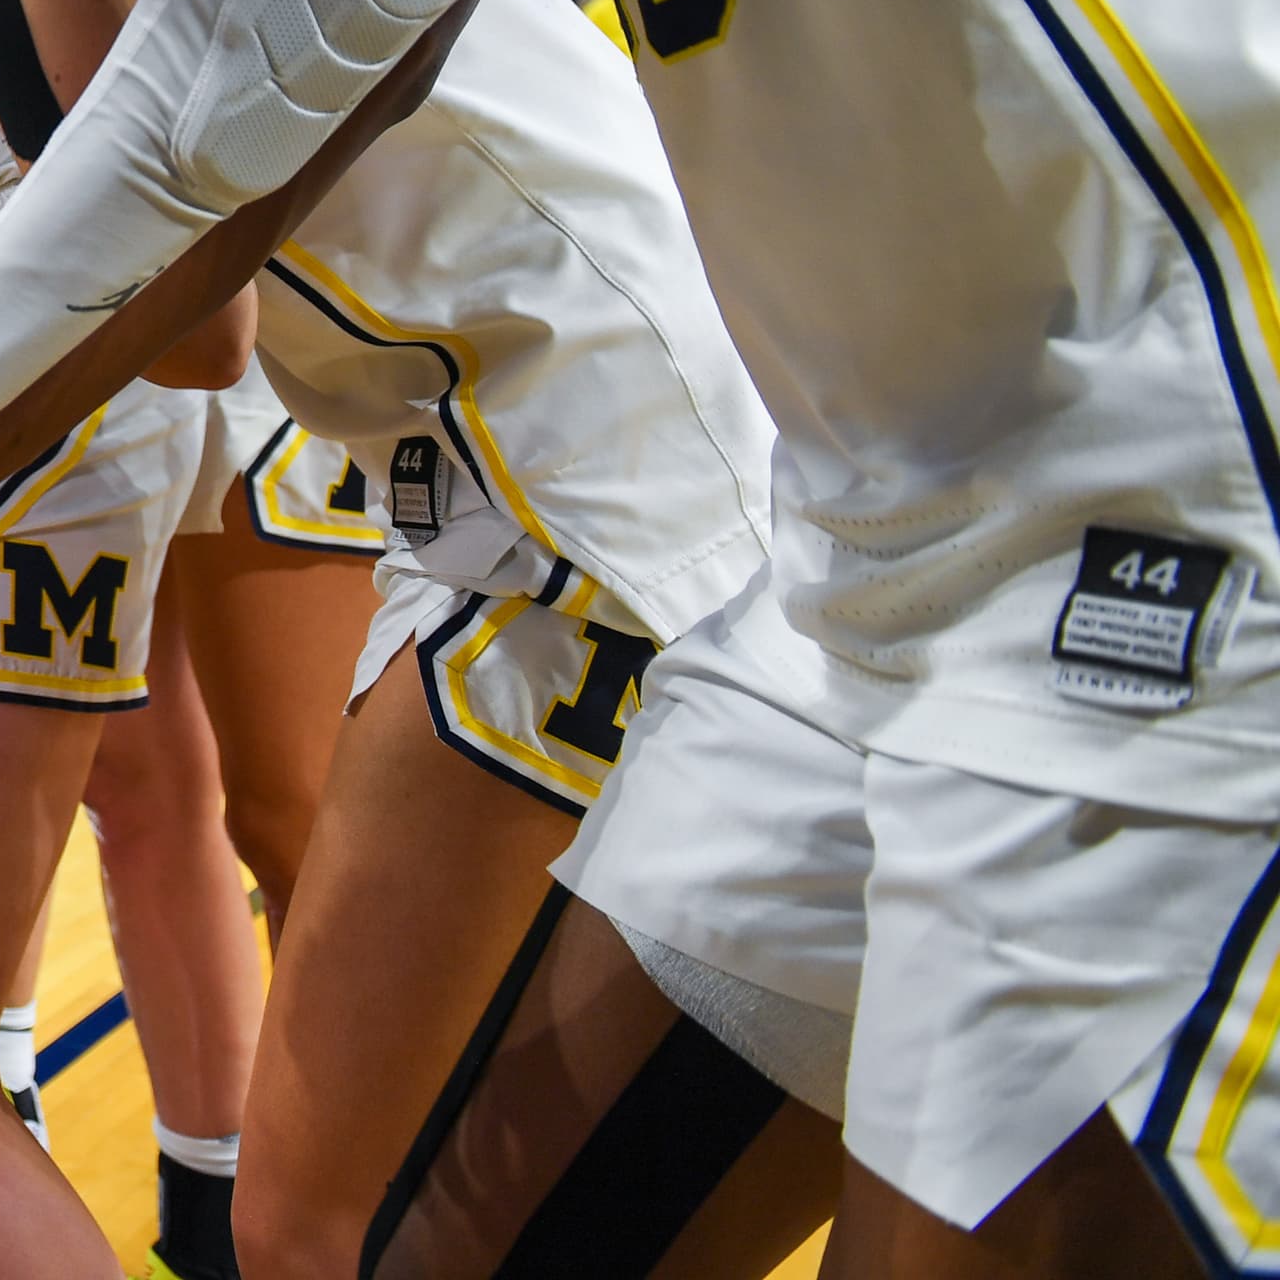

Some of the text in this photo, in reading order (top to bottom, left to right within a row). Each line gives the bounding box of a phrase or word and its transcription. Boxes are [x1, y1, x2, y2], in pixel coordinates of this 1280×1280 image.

[398, 448, 423, 472] 44
[1109, 547, 1182, 597] 44
[0, 538, 130, 672] M
